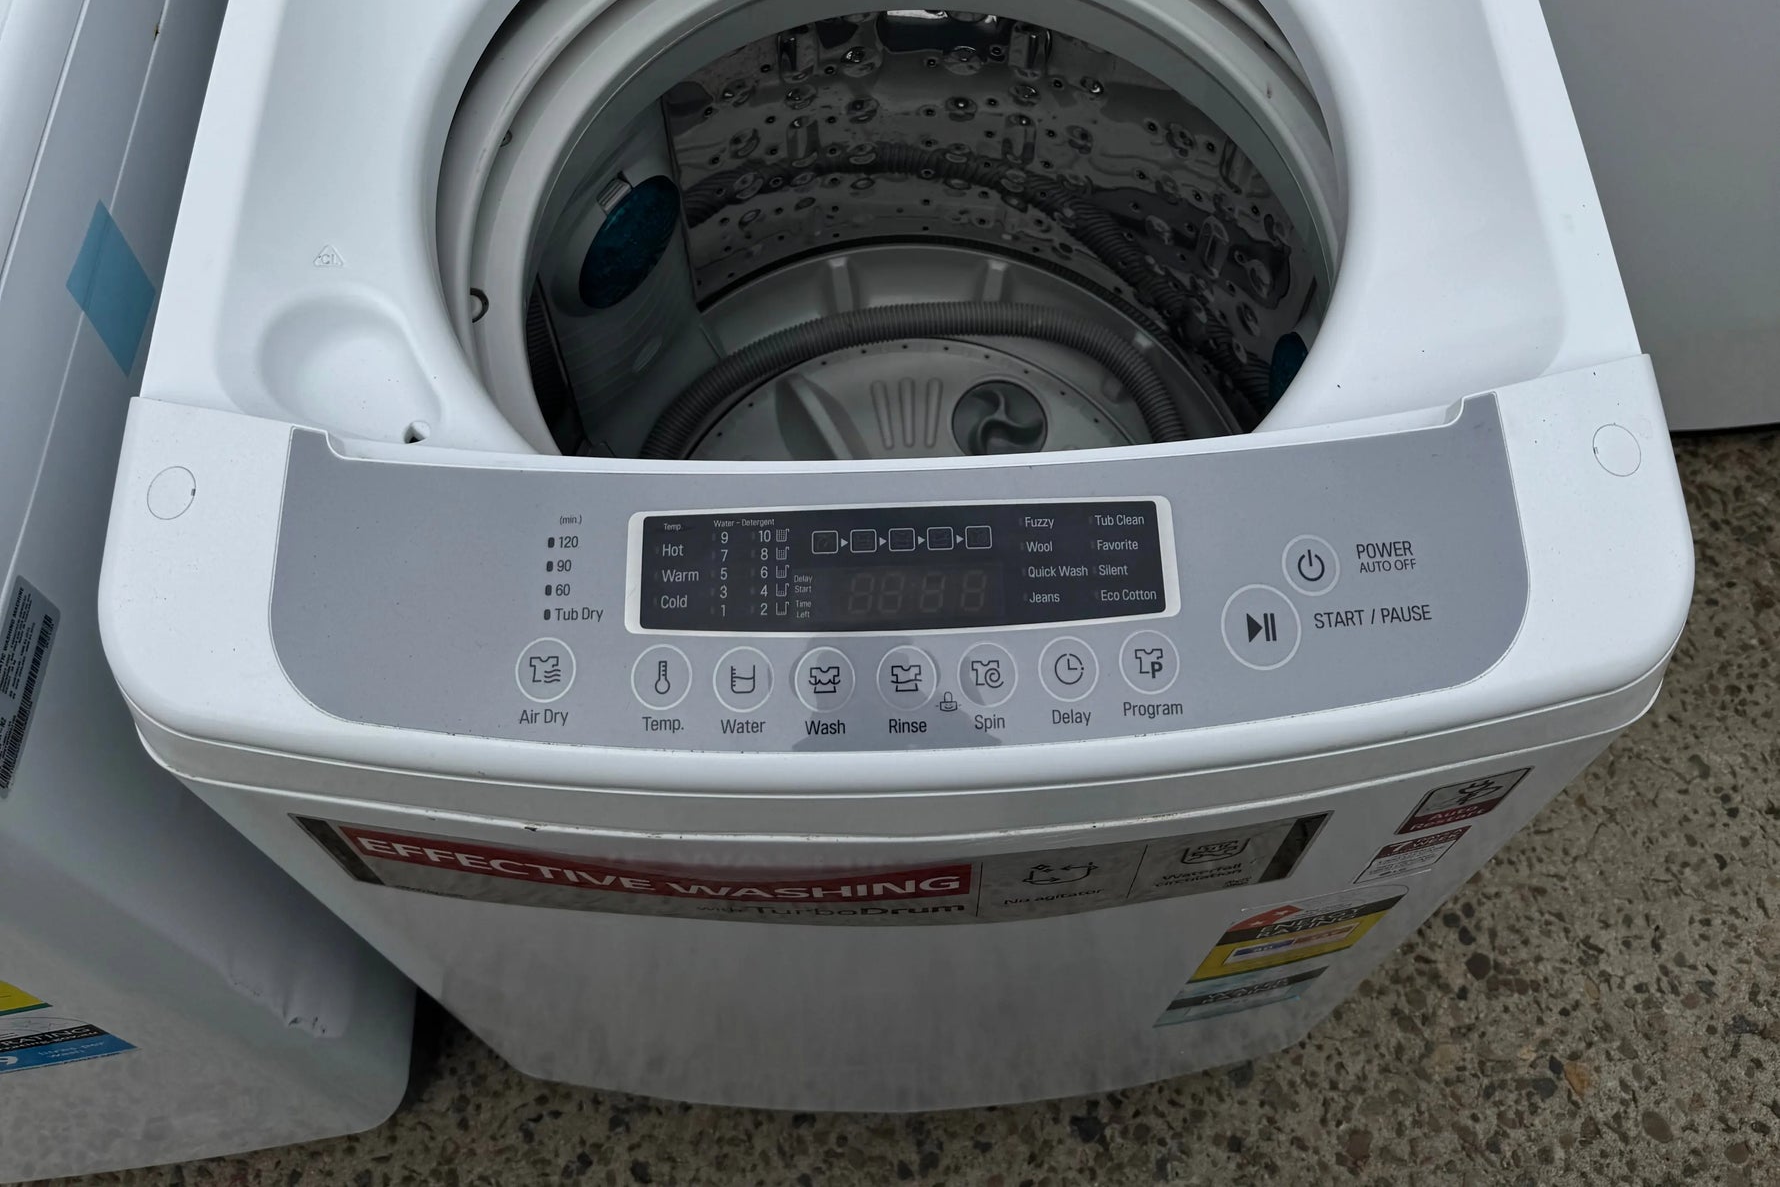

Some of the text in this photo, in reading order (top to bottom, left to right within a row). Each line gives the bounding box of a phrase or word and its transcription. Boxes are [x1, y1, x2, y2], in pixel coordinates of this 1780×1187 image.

[742, 518, 775, 528] Detergent
[1024, 516, 1054, 529] Fuzzy
[1094, 514, 1144, 526] Tub Clean
[559, 536, 579, 548] 120
[720, 530, 772, 544] 9 10
[662, 544, 684, 557] Hot
[1026, 541, 1053, 552] Wool
[1096, 539, 1138, 550] Favorite
[1356, 540, 1414, 560] POWER
[720, 548, 768, 562] 7 8
[556, 560, 572, 572] 90
[720, 566, 768, 580] 5 6
[1028, 566, 1088, 578] Quick Wash
[1098, 564, 1129, 576] Silent
[1360, 558, 1416, 574] AUTO OFF
[662, 569, 700, 583] Warm
[794, 574, 813, 584] Delay
[555, 583, 571, 596] 60
[720, 584, 768, 598] 3 4
[794, 584, 812, 594] Start
[1100, 588, 1157, 602] Eco Cotton
[660, 594, 688, 609] Cold
[796, 600, 812, 608] Time
[1028, 592, 1060, 604] Jeans
[554, 606, 604, 622] Tub Dry
[720, 602, 768, 617] 1 2
[796, 610, 811, 618] Left
[1314, 604, 1433, 630] START / PAUSE
[519, 708, 569, 726] Air Dry
[1052, 708, 1092, 726] Delay
[1123, 702, 1184, 719] Program
[642, 716, 685, 734] Temp.
[720, 718, 766, 734] Water
[804, 720, 846, 735] Wash
[888, 718, 928, 734] Rinse
[974, 714, 1006, 733] Spin
[357, 836, 960, 898] EFFECTIVE WASHING
[1163, 863, 1242, 881] Waterfall
[1155, 869, 1242, 888] circulation
[1004, 888, 1104, 905] No agitator
[750, 904, 966, 916] TurboDrum
[1261, 906, 1367, 932] ENERGY
[1256, 914, 1359, 939] RATING
